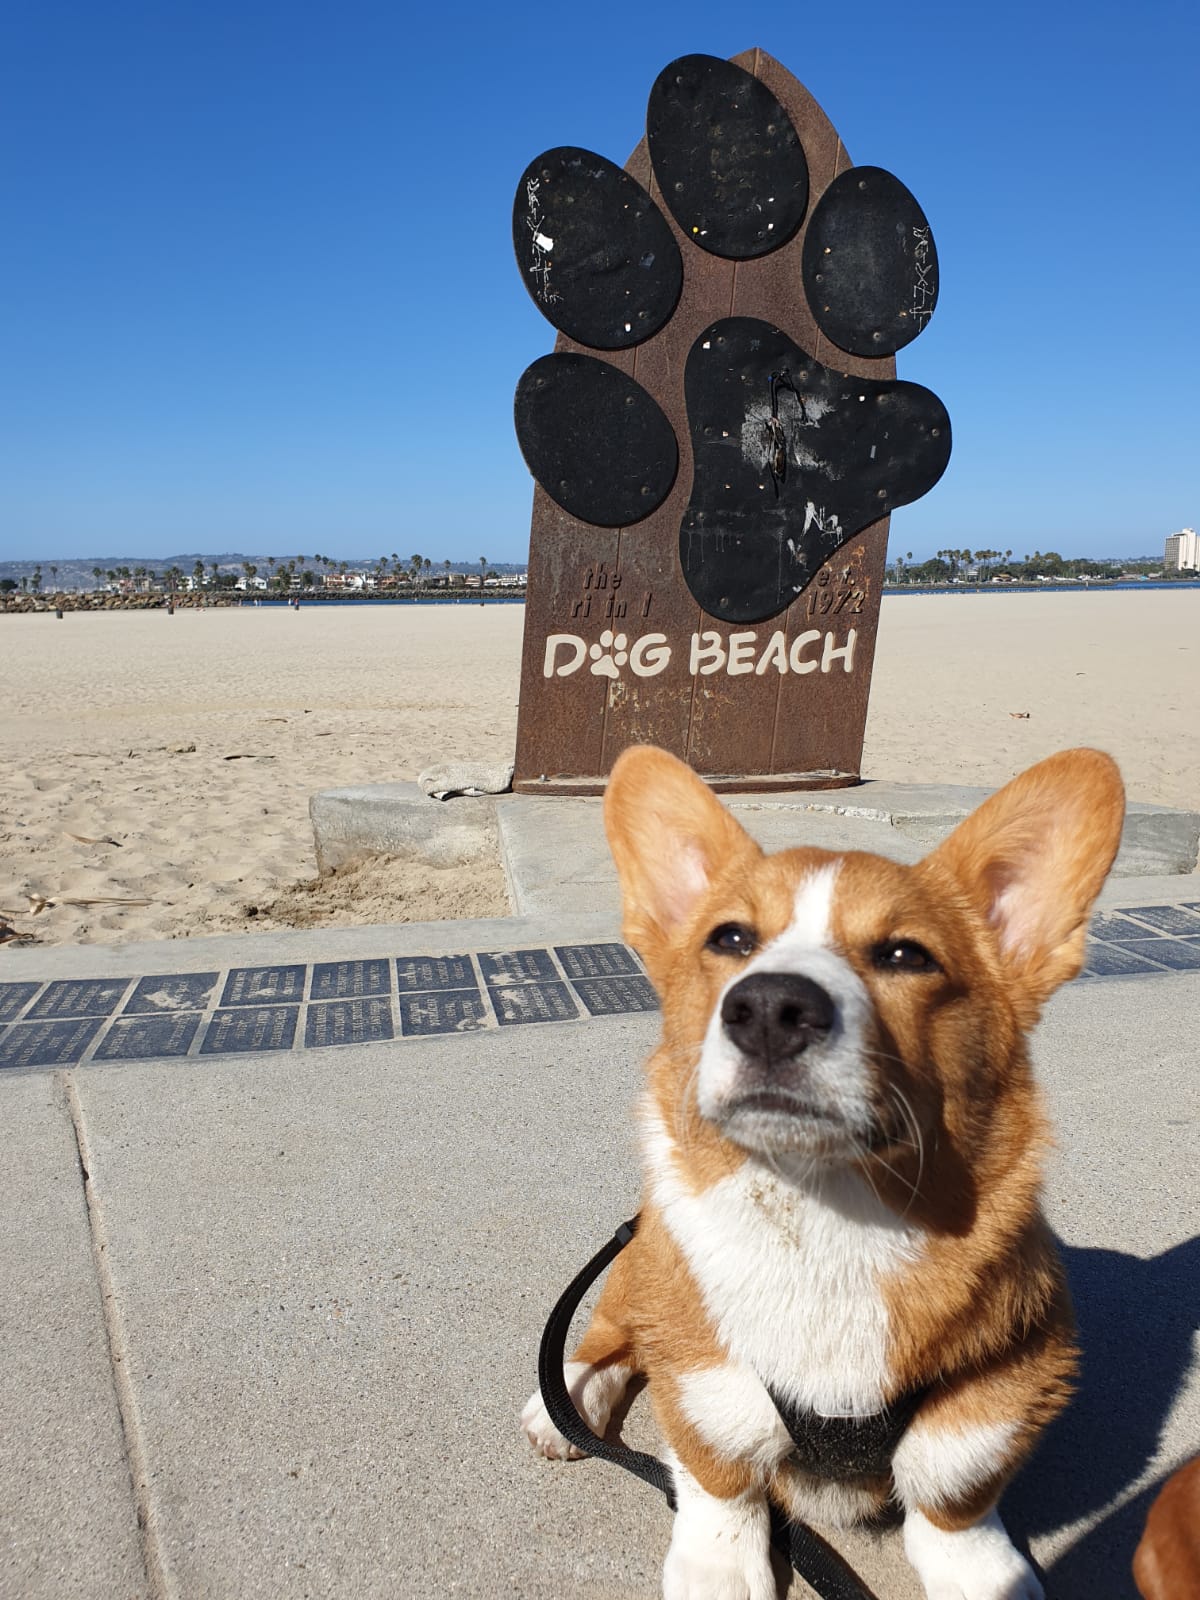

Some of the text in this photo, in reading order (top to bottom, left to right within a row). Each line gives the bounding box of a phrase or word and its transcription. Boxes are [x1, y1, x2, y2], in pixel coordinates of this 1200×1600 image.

[583, 563, 622, 590] the
[807, 590, 866, 615] 1972
[689, 628, 857, 676] BEACH
